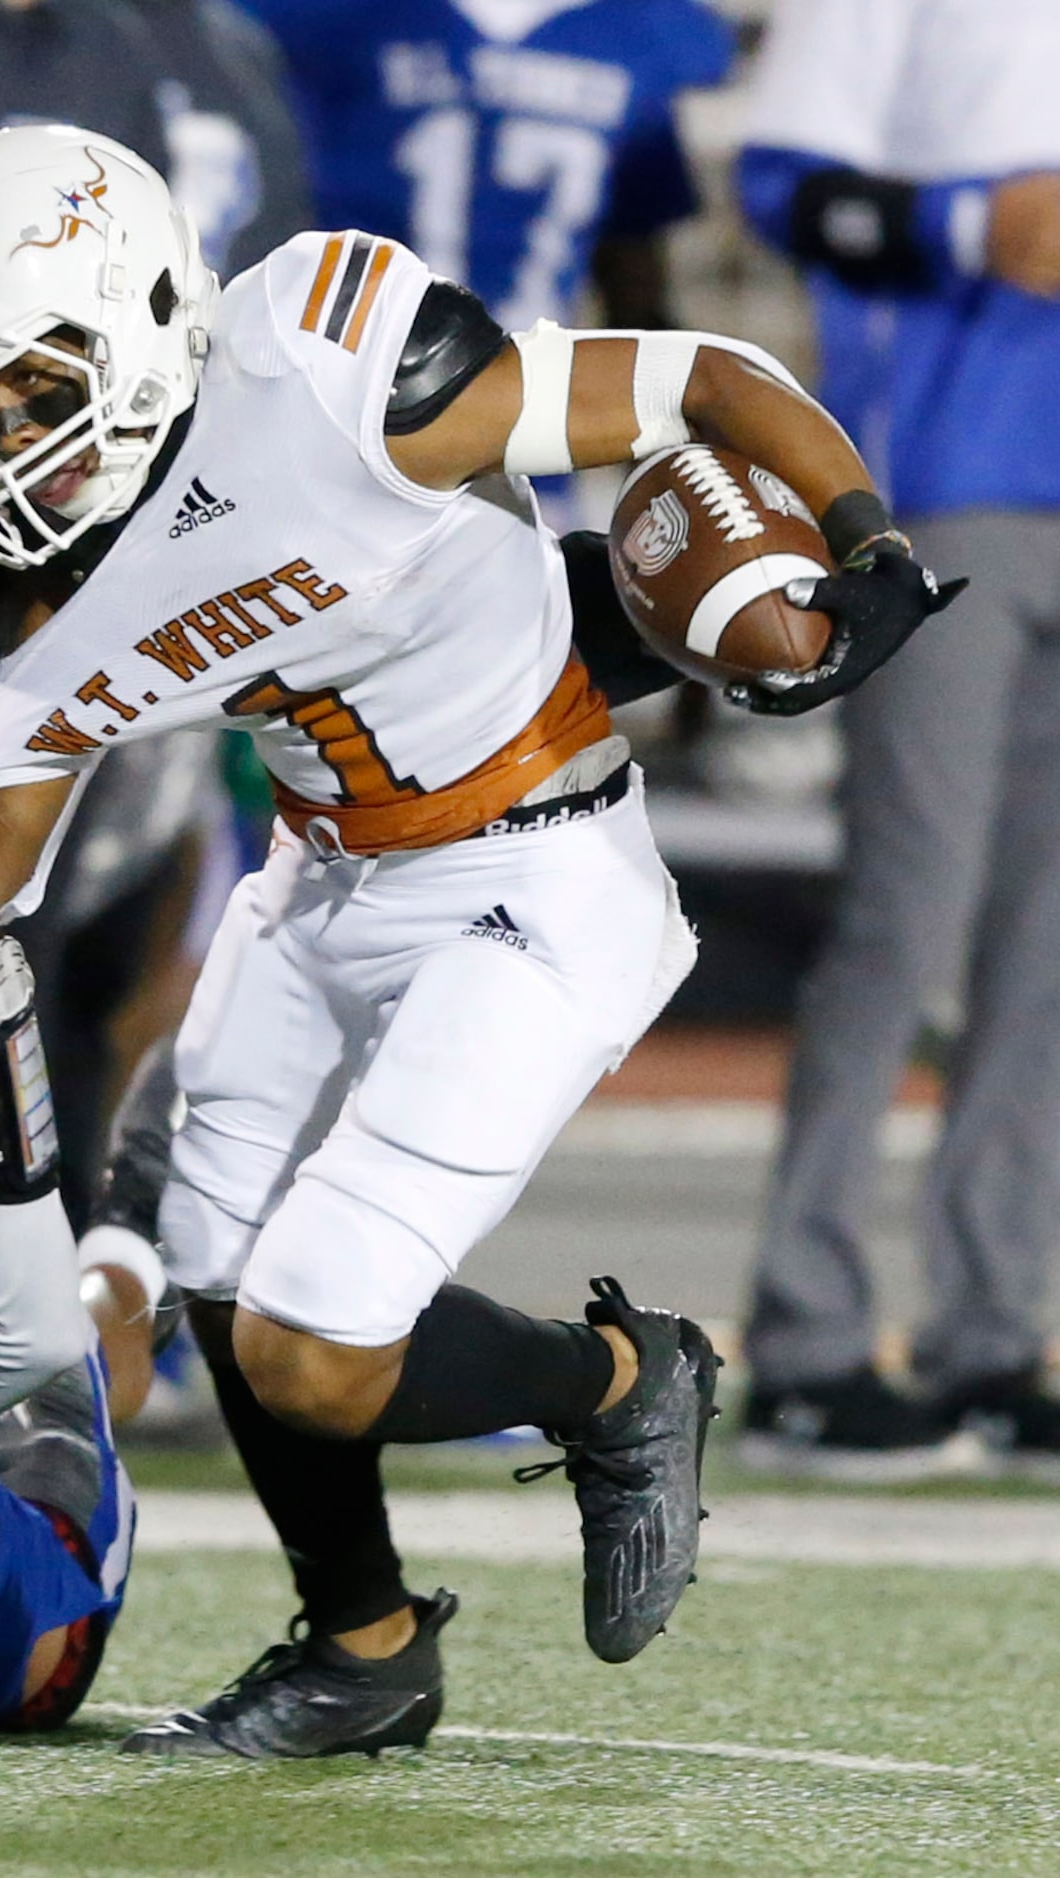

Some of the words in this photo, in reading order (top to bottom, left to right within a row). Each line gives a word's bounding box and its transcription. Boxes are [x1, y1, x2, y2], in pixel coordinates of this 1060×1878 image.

[391, 107, 607, 332] 17
[169, 498, 236, 539] adidas
[133, 557, 349, 683] WHITE
[221, 669, 427, 805] 1
[461, 924, 528, 951] adidas
